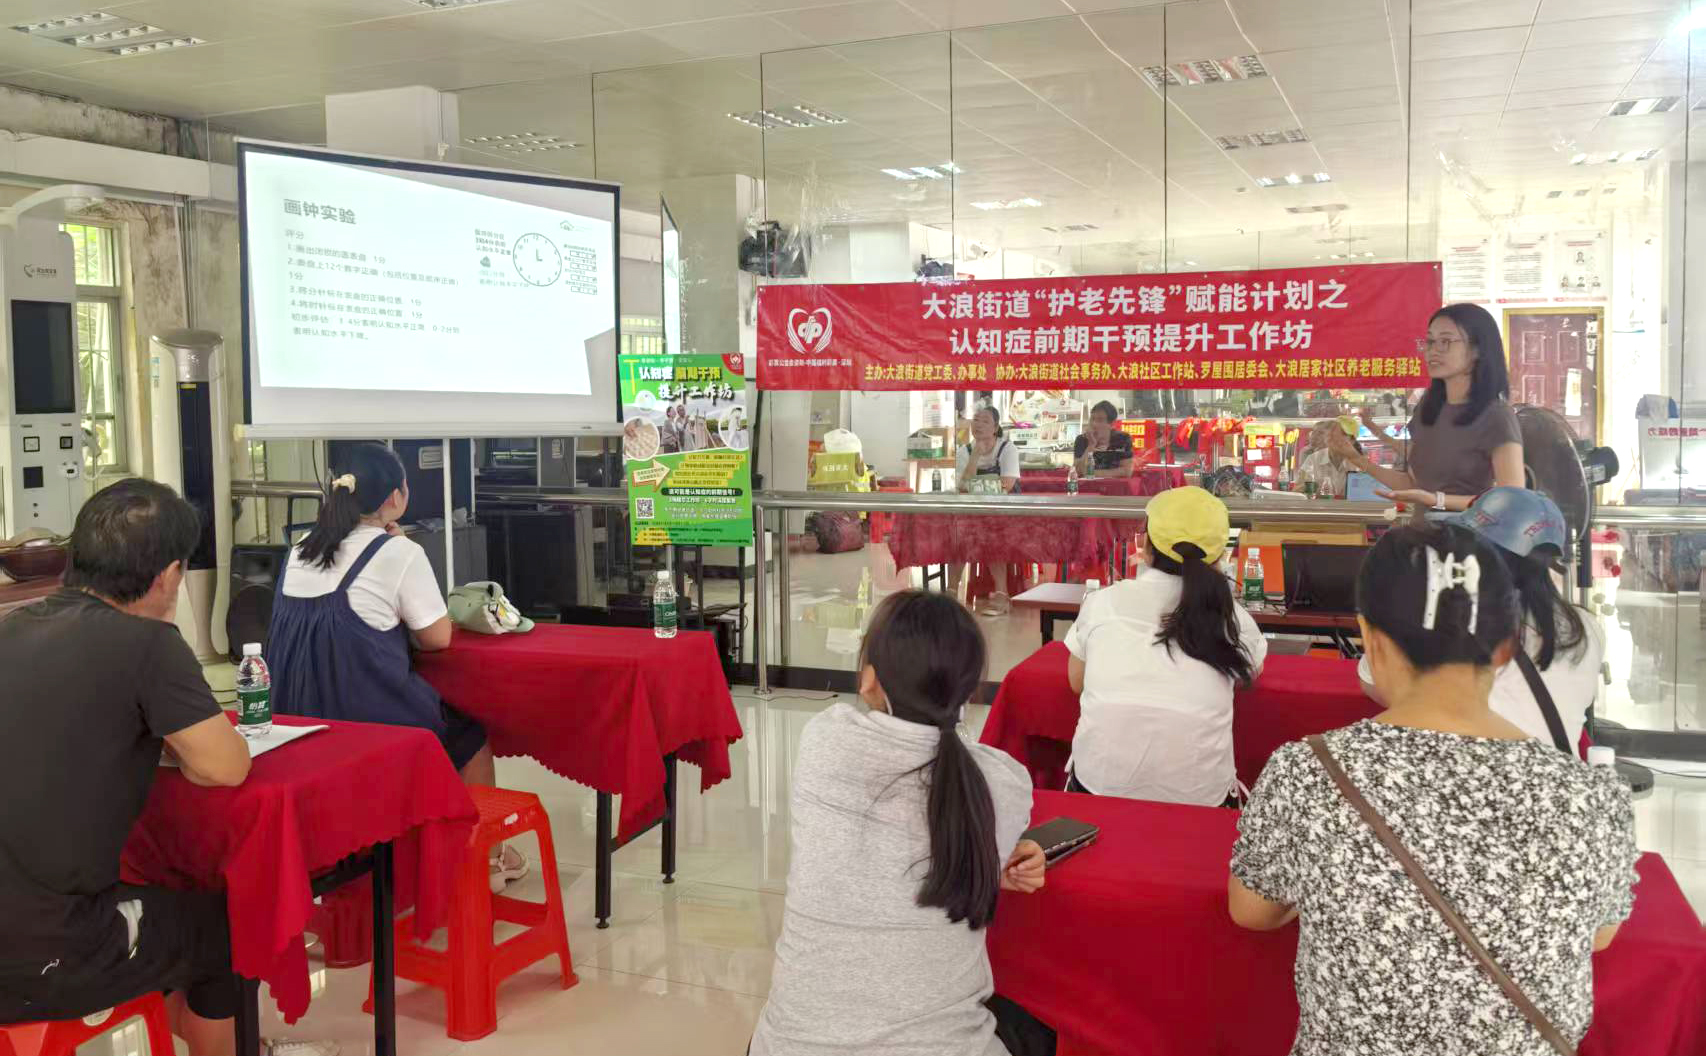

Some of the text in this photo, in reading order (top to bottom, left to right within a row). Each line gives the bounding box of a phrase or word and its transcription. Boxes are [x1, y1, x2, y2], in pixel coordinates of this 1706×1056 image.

[283, 198, 357, 225] 画钟实验
[922, 279, 1349, 320] 大浪街道“护老先锋”赋能计划之
[949, 319, 1314, 355] 认知症前期干预提升工作坊
